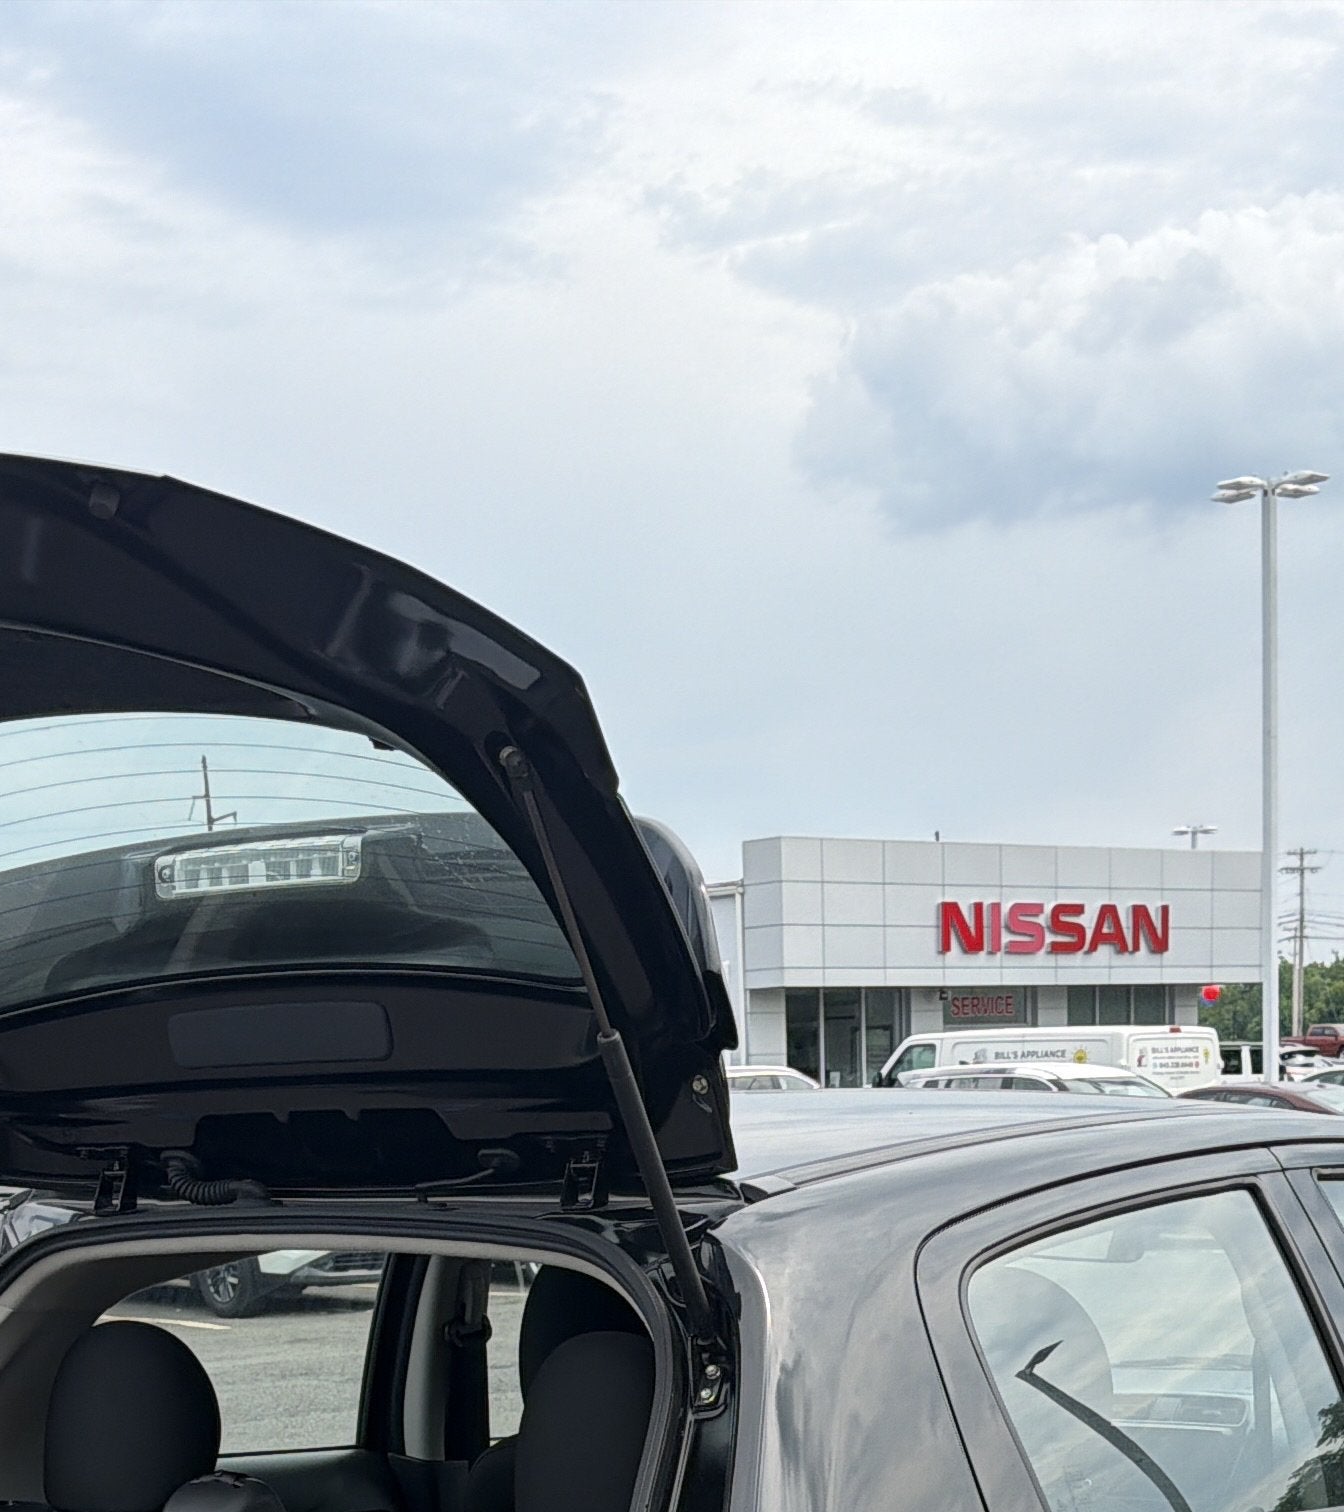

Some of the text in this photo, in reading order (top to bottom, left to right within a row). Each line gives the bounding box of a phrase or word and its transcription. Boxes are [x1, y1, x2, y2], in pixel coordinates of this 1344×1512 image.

[940, 901, 1170, 954] NISSAN
[950, 995, 1014, 1017] SERVICE
[994, 1049, 1067, 1060] BILL'S APPLIANCE
